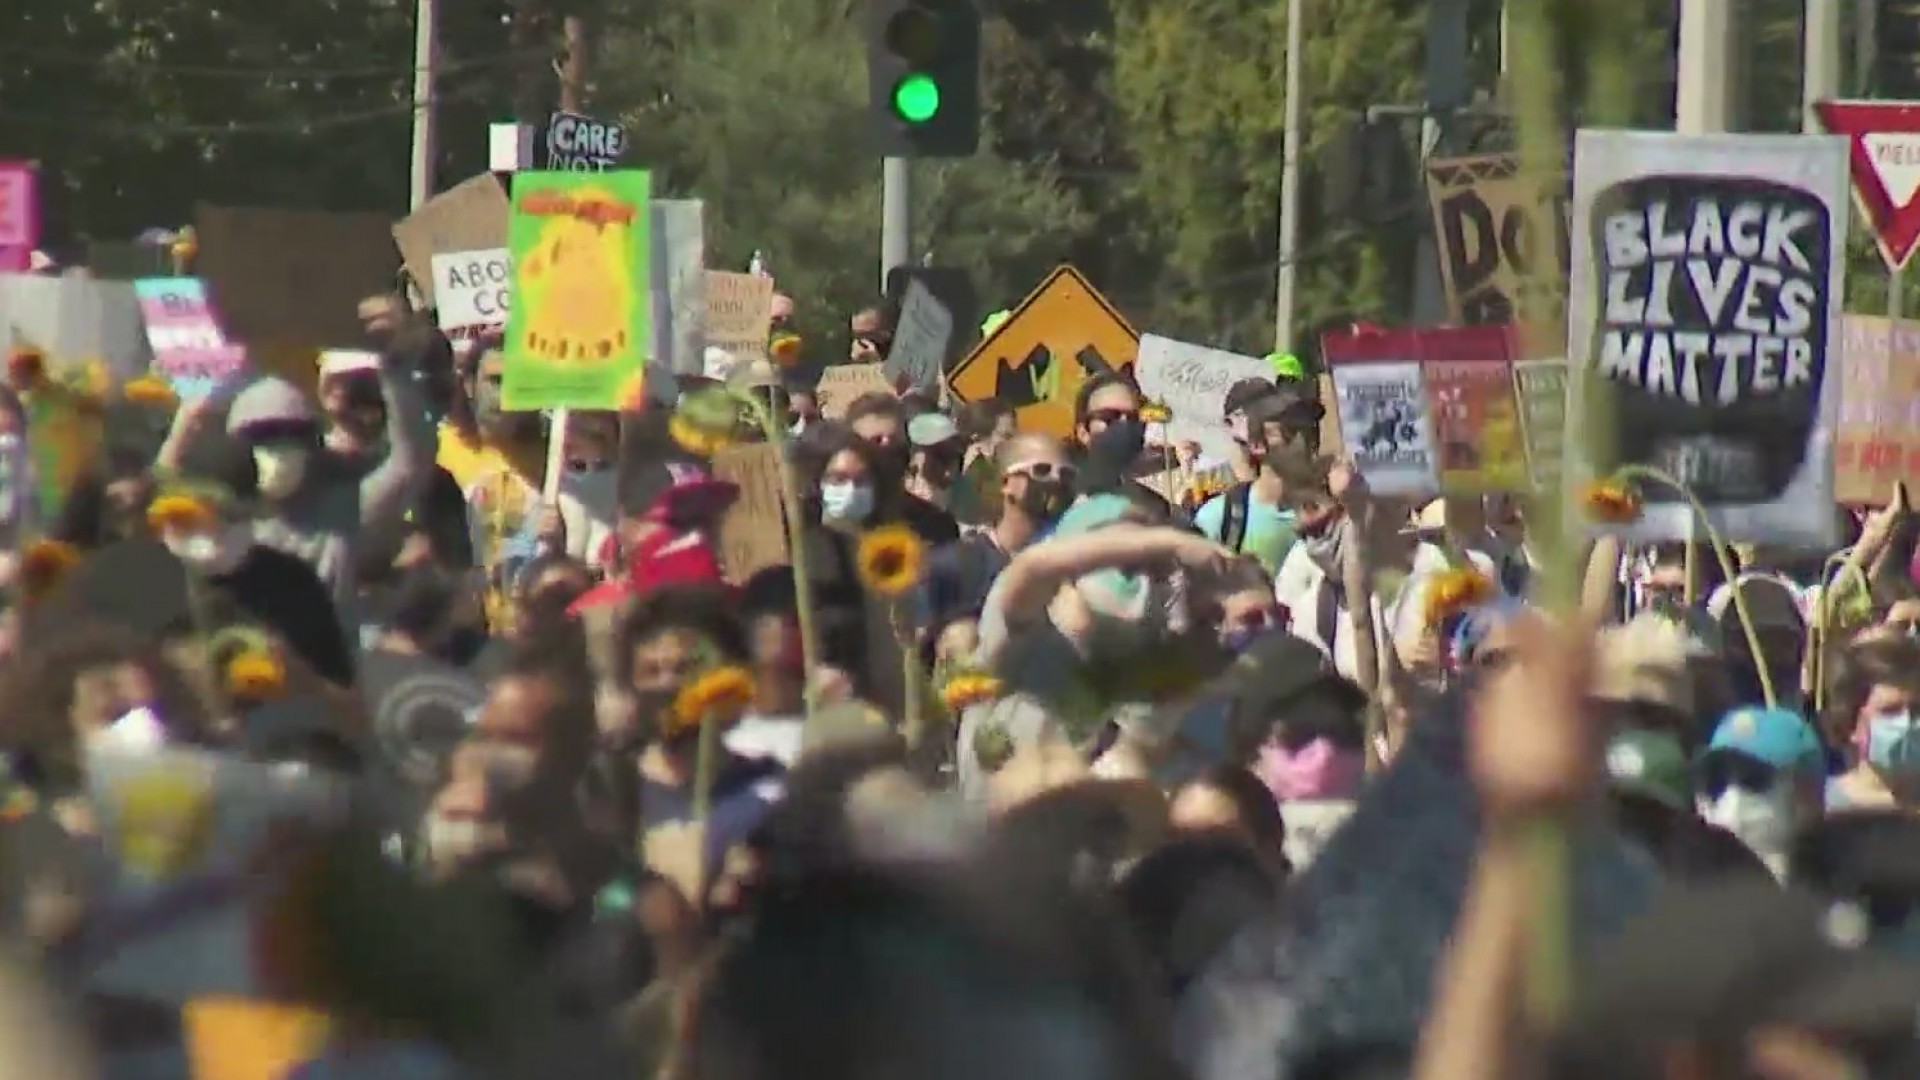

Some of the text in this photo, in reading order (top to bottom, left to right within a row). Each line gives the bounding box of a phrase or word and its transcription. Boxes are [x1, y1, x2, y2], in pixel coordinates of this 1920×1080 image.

[554, 117, 621, 157] CARE
[1605, 198, 1817, 272] BLACK
[1605, 257, 1816, 334] LIVES
[1600, 331, 1812, 404] MATTER
